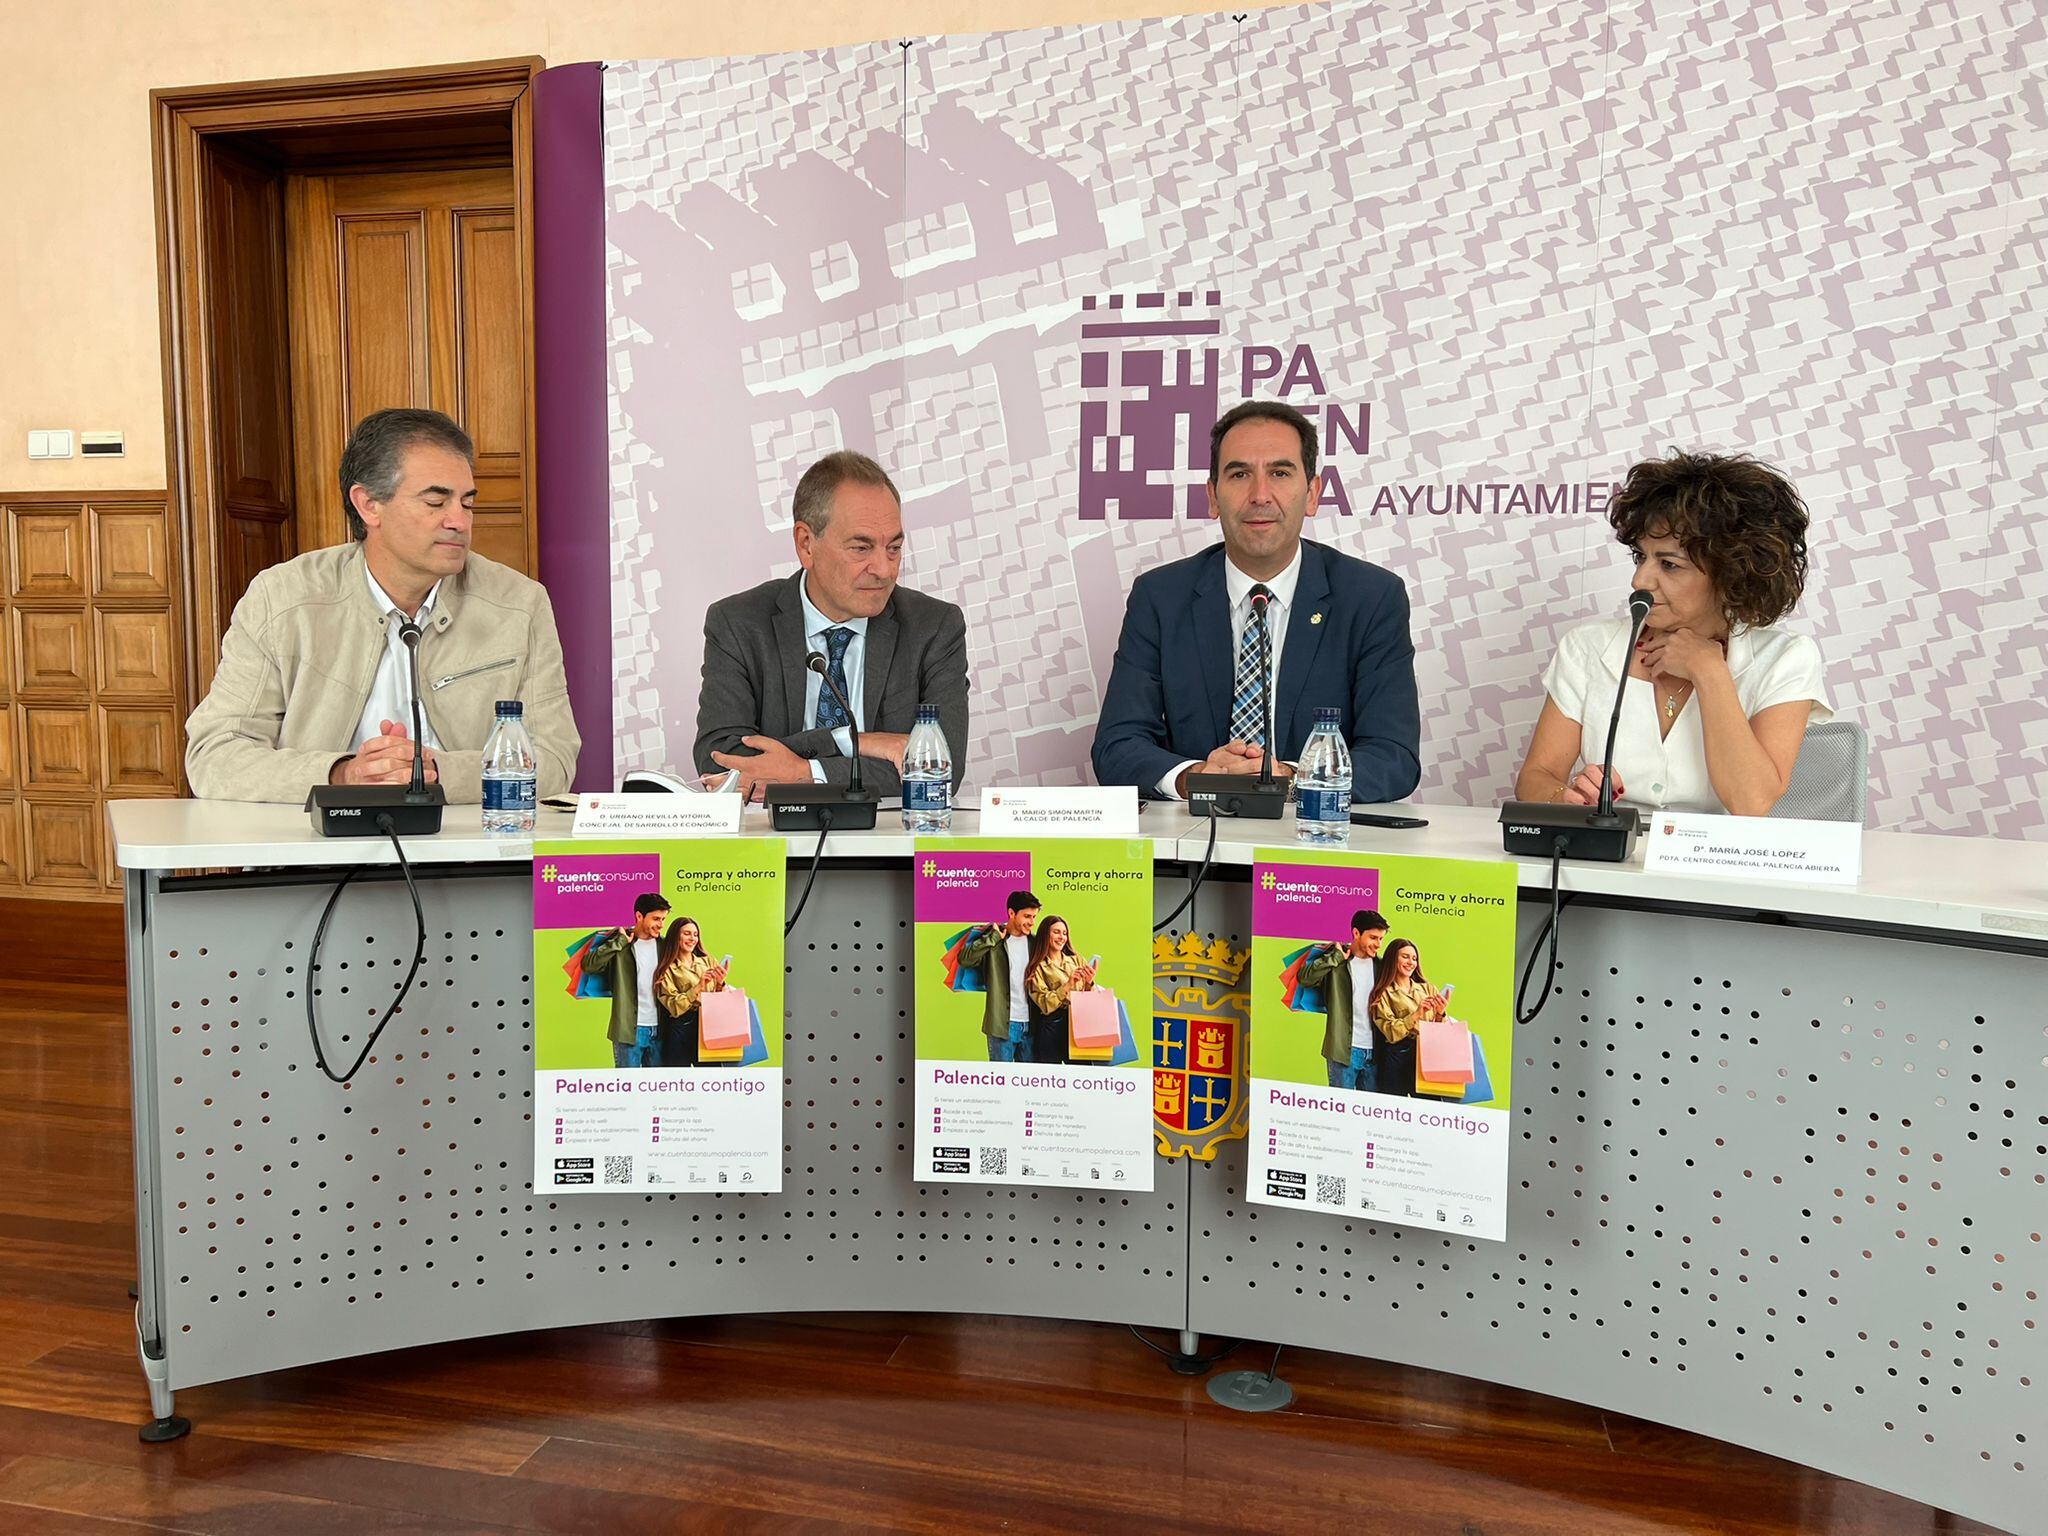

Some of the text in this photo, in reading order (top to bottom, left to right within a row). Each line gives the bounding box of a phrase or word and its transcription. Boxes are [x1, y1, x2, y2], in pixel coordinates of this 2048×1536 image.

[1241, 343, 1326, 398] PA
[329, 808, 361, 817] OPTIMUS
[778, 805, 807, 813] OPTIMUS
[1509, 826, 1541, 834] OPTIMUS
[1682, 856, 1714, 864] CENTRO
[1715, 858, 1761, 867] COMERCIAL
[1763, 861, 1803, 870] PALENCIA
[1804, 864, 1841, 873] ABIERTA
[676, 868, 776, 881] Compra y ahorra
[1046, 868, 1143, 881] Compra y ahorra
[557, 882, 605, 895] palencia
[676, 881, 742, 893] en Palencia
[936, 878, 980, 889] palencia
[1046, 881, 1109, 892] en Palencia
[1276, 892, 1322, 904] palencia
[1396, 888, 1505, 906] Compra y ahorra
[1395, 903, 1465, 917] en Palencia
[556, 1078, 765, 1095] Palencia cuenta contigo
[934, 1069, 1136, 1095] Palencia cuenta contigo
[1269, 1089, 1490, 1136] Palencia cuenta contigo
[647, 1150, 769, 1159] www.cuentaconsumopalencia.com
[1021, 1144, 1141, 1157] www.cuentaconsumopalencia.com
[1278, 1189, 1294, 1197] Google
[1294, 1191, 1304, 1199] Play
[1361, 1176, 1492, 1202] www.cuentaconsumopalencia.com
